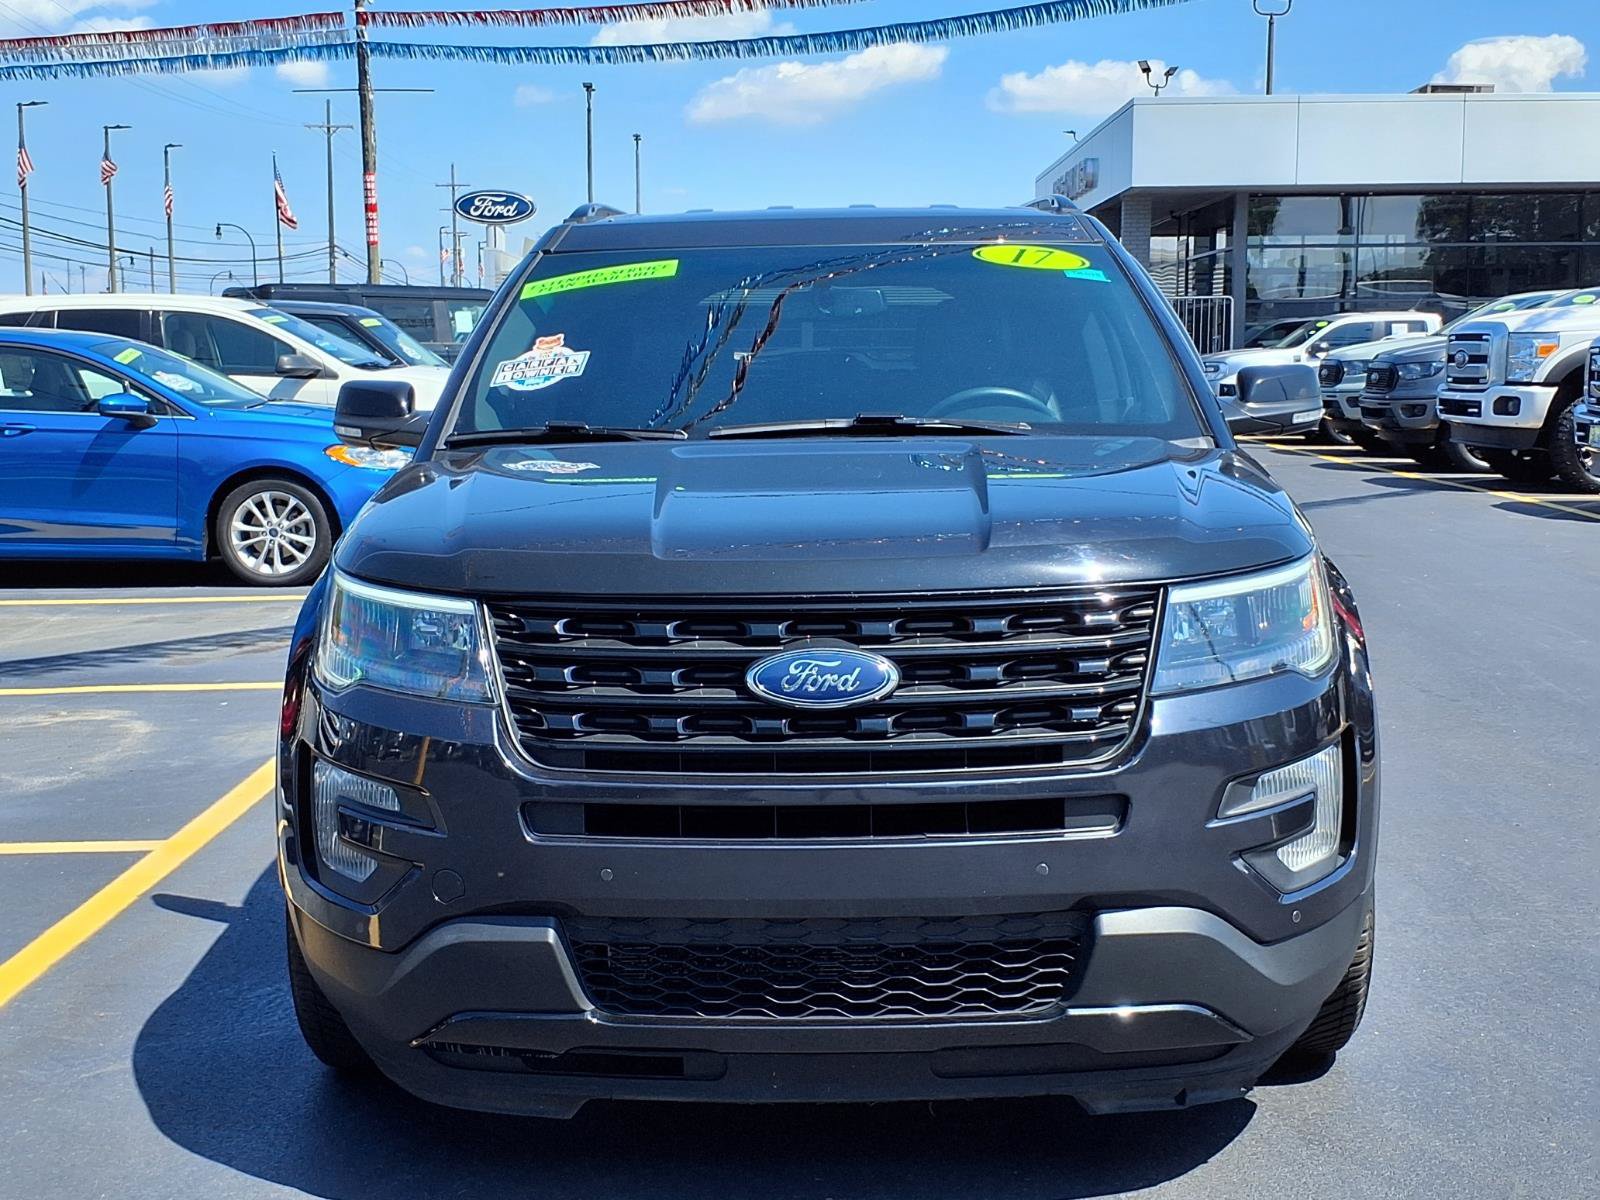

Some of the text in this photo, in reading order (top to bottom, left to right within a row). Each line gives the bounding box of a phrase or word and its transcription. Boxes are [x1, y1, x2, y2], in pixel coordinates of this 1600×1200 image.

[470, 196, 519, 217] Ford
[1011, 248, 1055, 265] 17
[530, 264, 668, 291] EXTENDED SERVICE
[538, 271, 657, 295] PLAN AVAILABLE
[781, 659, 861, 692] Ford
